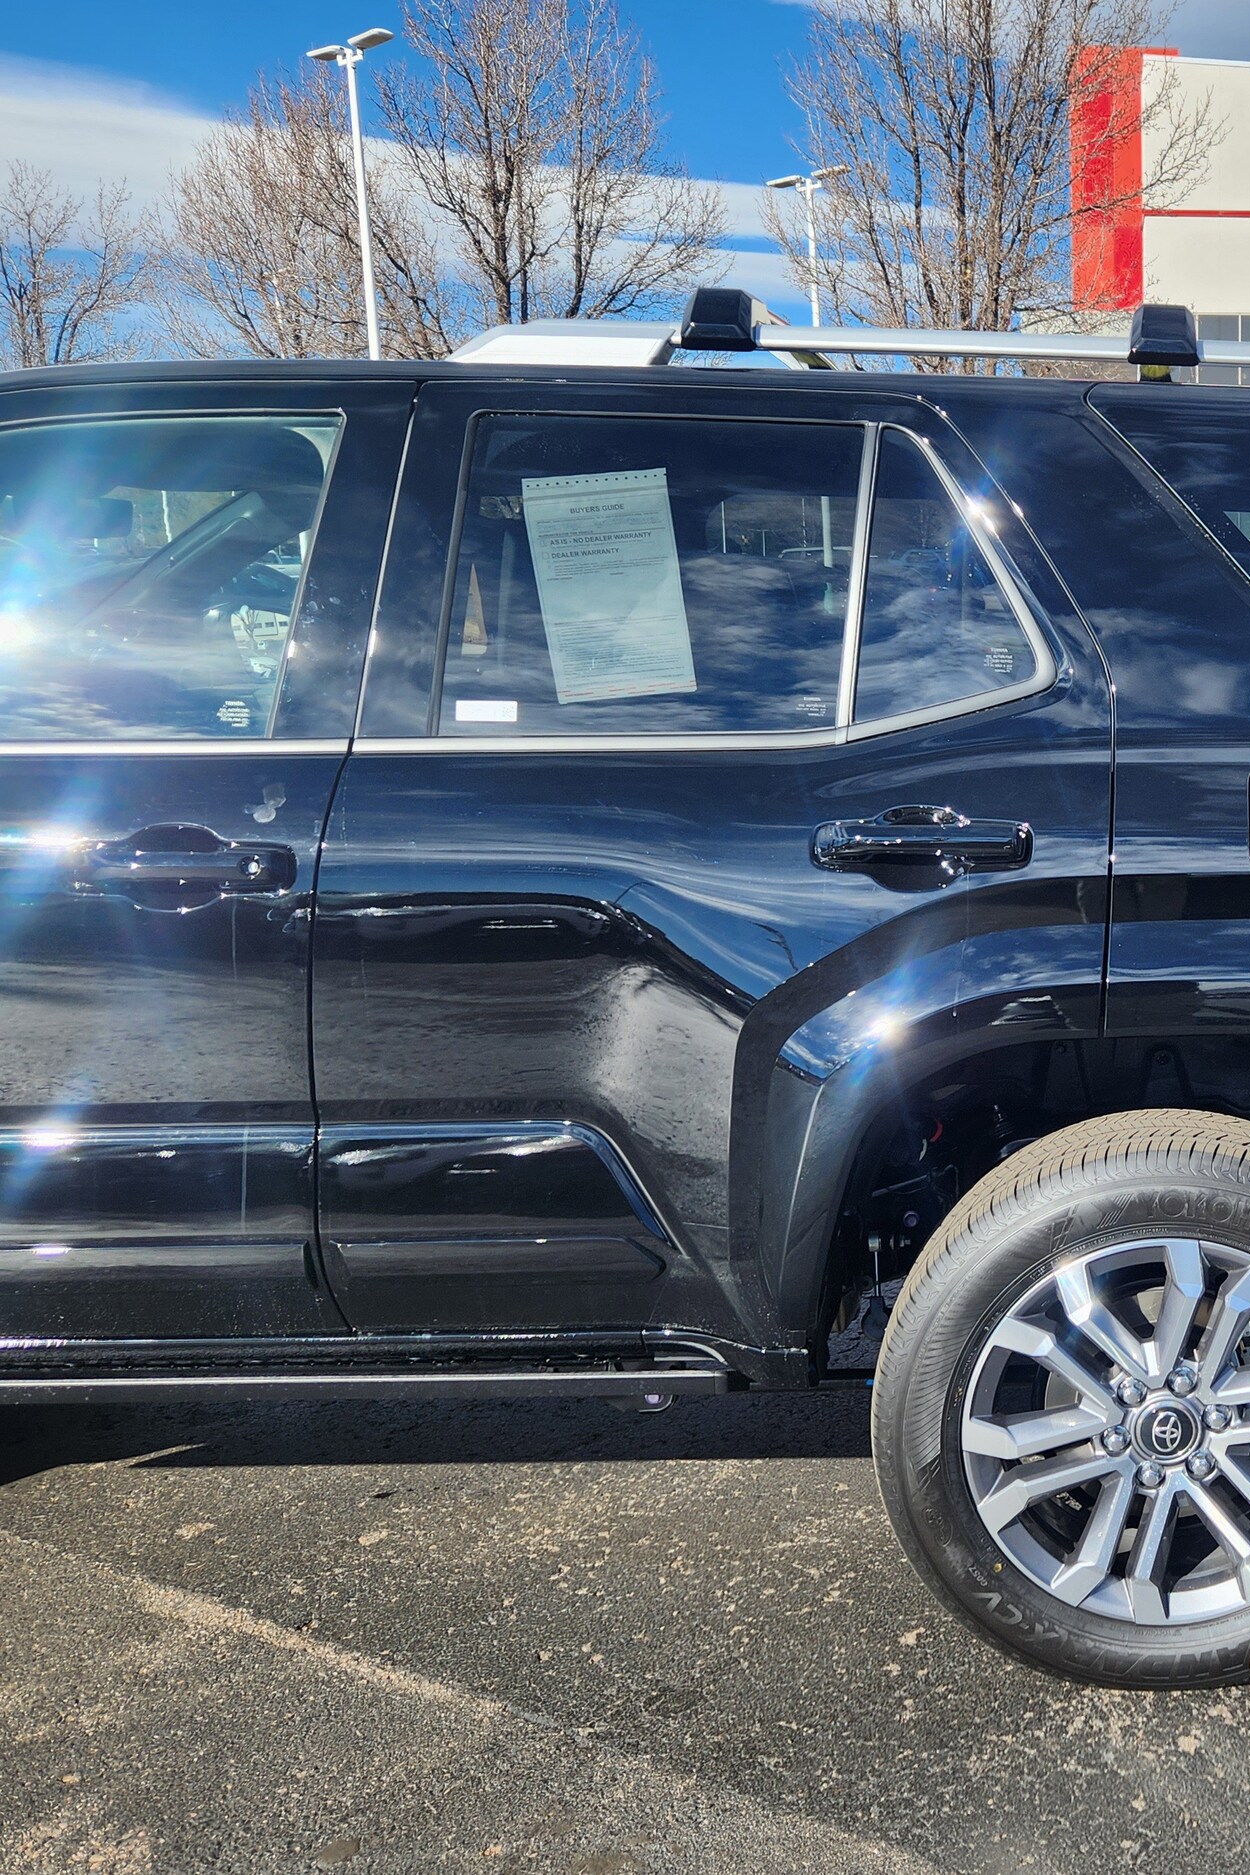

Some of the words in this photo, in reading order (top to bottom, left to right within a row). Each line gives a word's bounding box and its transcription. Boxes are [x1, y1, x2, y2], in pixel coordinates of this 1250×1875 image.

[570, 505, 600, 514] BUYERS
[585, 534, 613, 542] DEALER
[614, 532, 652, 540] WARRANTY
[581, 548, 620, 556] WARRANTY
[968, 1564, 989, 1587] G057
